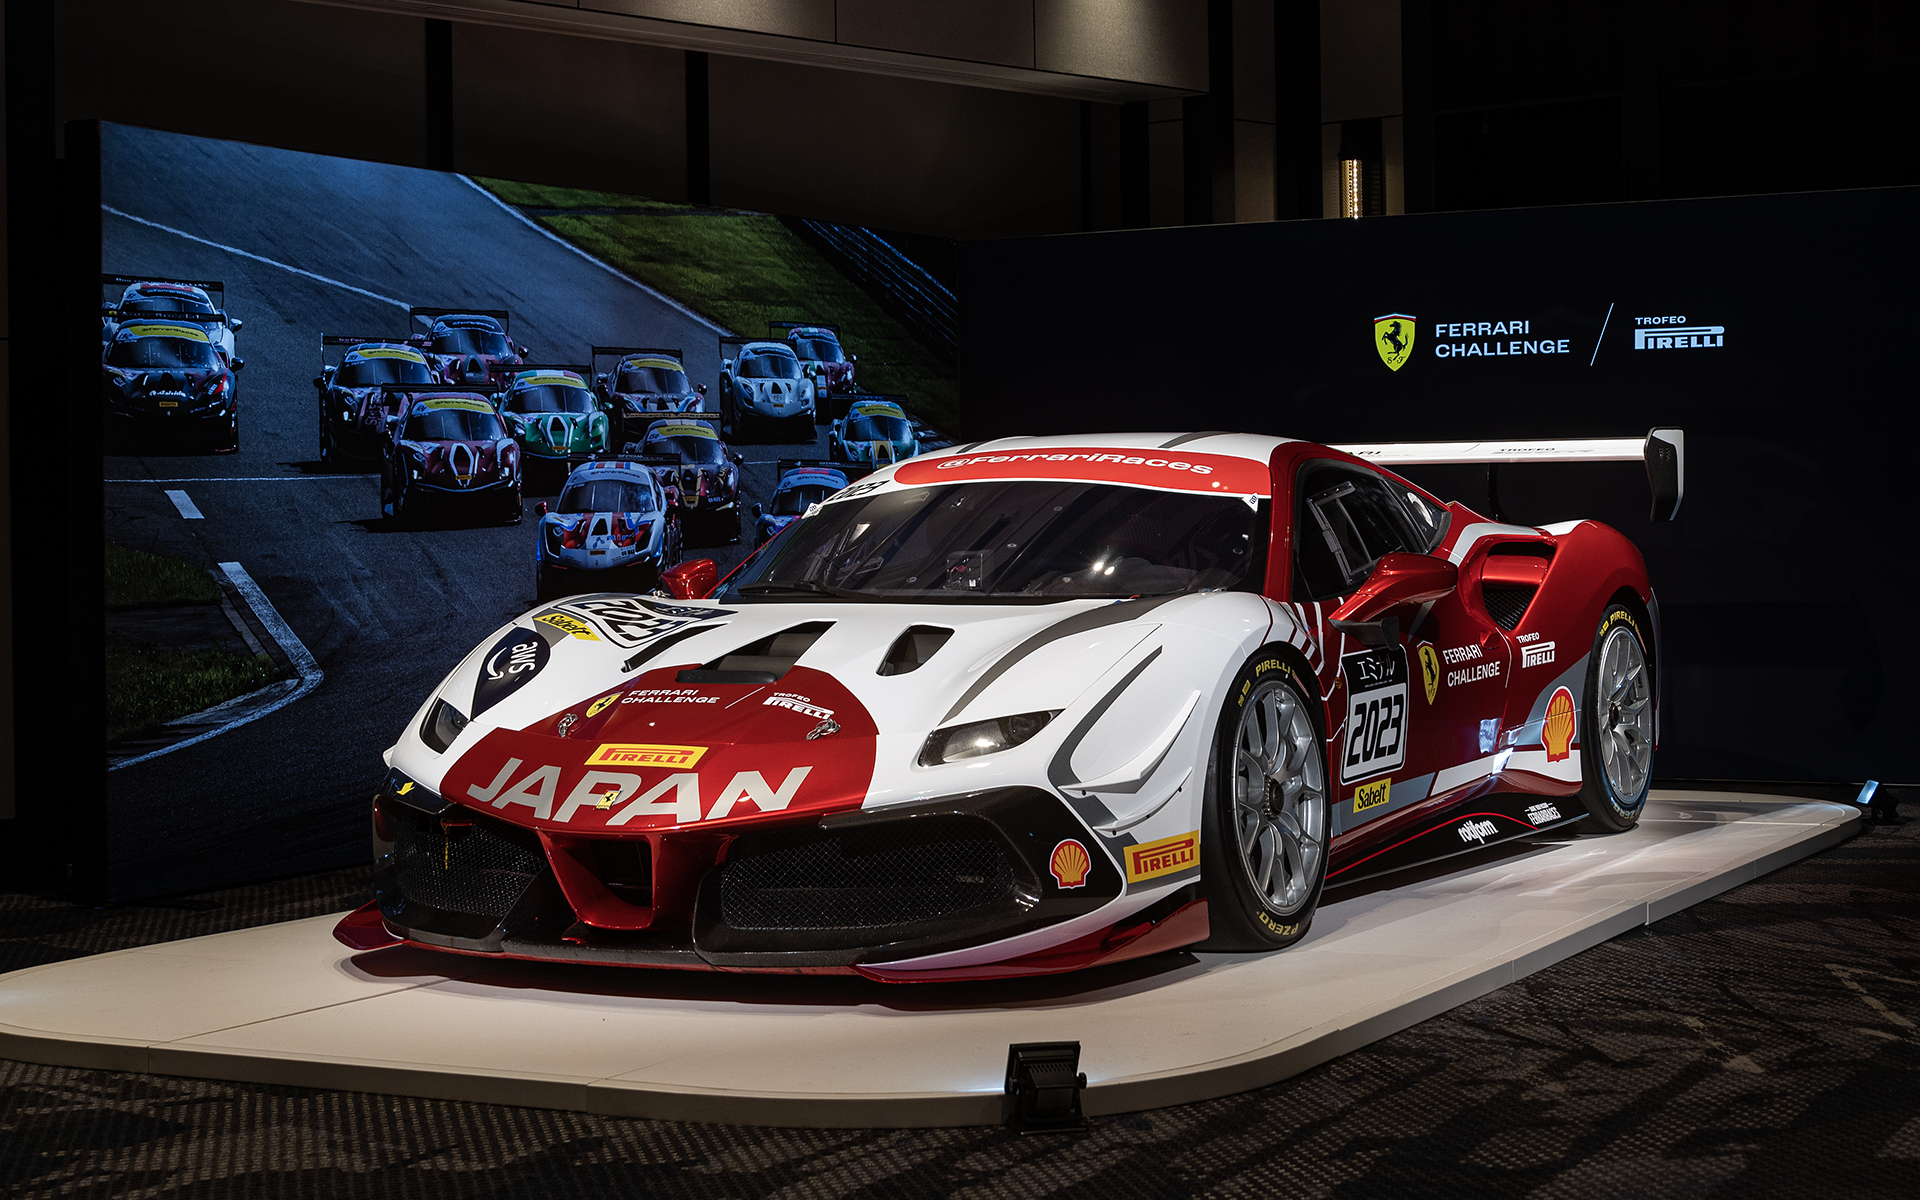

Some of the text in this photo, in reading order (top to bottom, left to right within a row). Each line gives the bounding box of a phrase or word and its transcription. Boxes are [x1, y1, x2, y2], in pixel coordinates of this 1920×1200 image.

[1435, 320, 1530, 338] FERRARI
[1635, 315, 1687, 325] TROFEO
[1435, 339, 1571, 358] CHALLENGE
[1634, 325, 1725, 350] PIRELLI
[936, 453, 1214, 475] @FerrariRaces
[543, 615, 592, 637] Sabelt
[1610, 610, 1635, 626] PIRELLI
[1516, 632, 1540, 644] TROFEO
[508, 641, 538, 674] aws
[1443, 644, 1483, 665] FERRARI
[1521, 640, 1556, 668] PIRELLI
[1255, 659, 1291, 677] PIRELLI
[1447, 661, 1501, 687] CHALLENGE
[763, 696, 835, 720] PIRELLI
[773, 692, 811, 702] TROFEO
[1346, 694, 1405, 768] 2023
[601, 747, 696, 765] PIRELLI
[466, 757, 814, 826] JAPAN
[1358, 783, 1387, 810] Sabelt
[1132, 838, 1194, 876] PIRELLI
